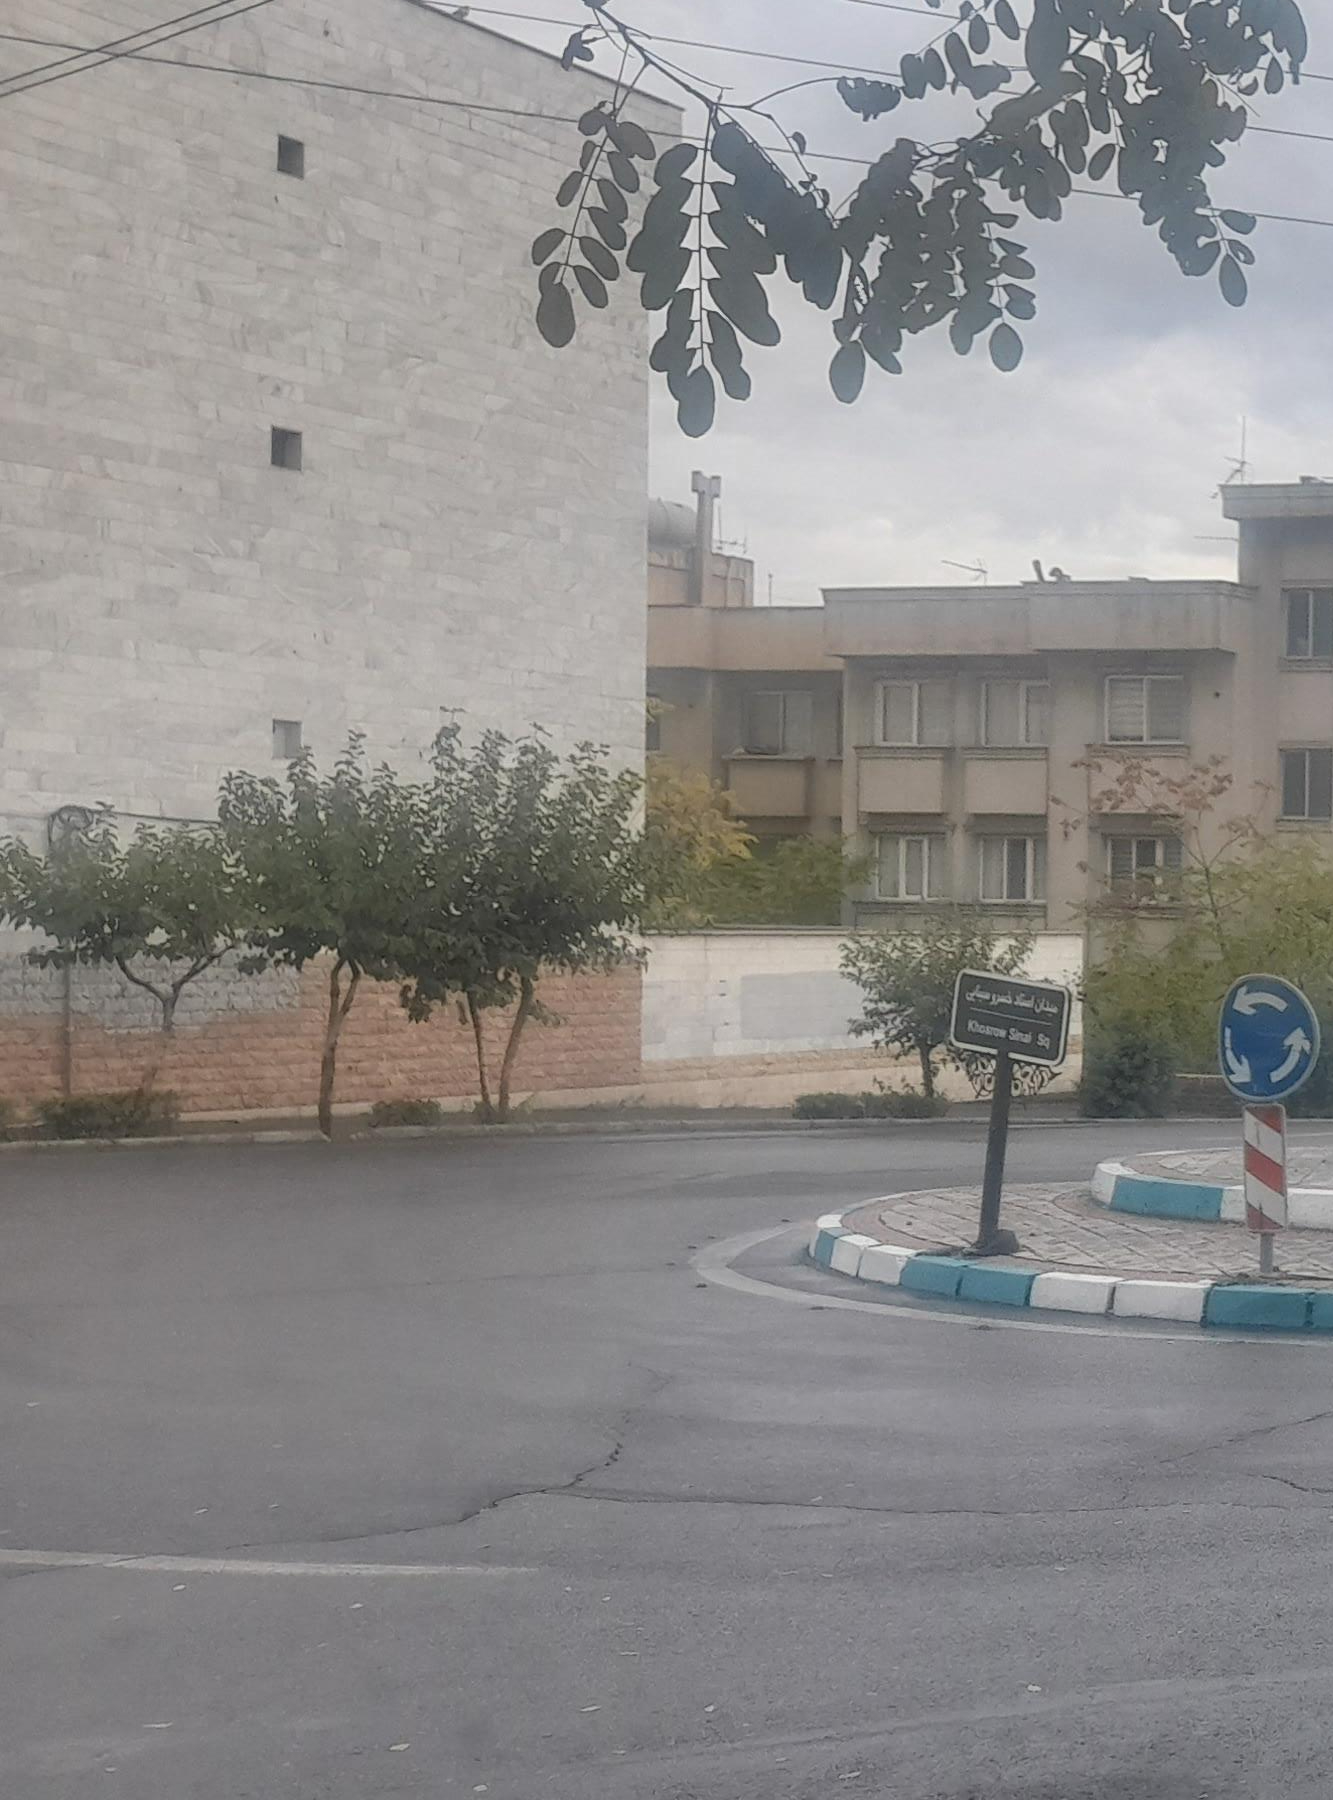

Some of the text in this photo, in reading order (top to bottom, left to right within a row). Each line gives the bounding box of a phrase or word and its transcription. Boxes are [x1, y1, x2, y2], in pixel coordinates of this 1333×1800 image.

[990, 990, 1013, 1006] خسرو
[1014, 994, 1035, 1009] استاد
[1035, 999, 1059, 1017] میدان
[967, 1019, 1007, 1039] Khosrow
[1036, 1033, 1051, 1050] Sq
